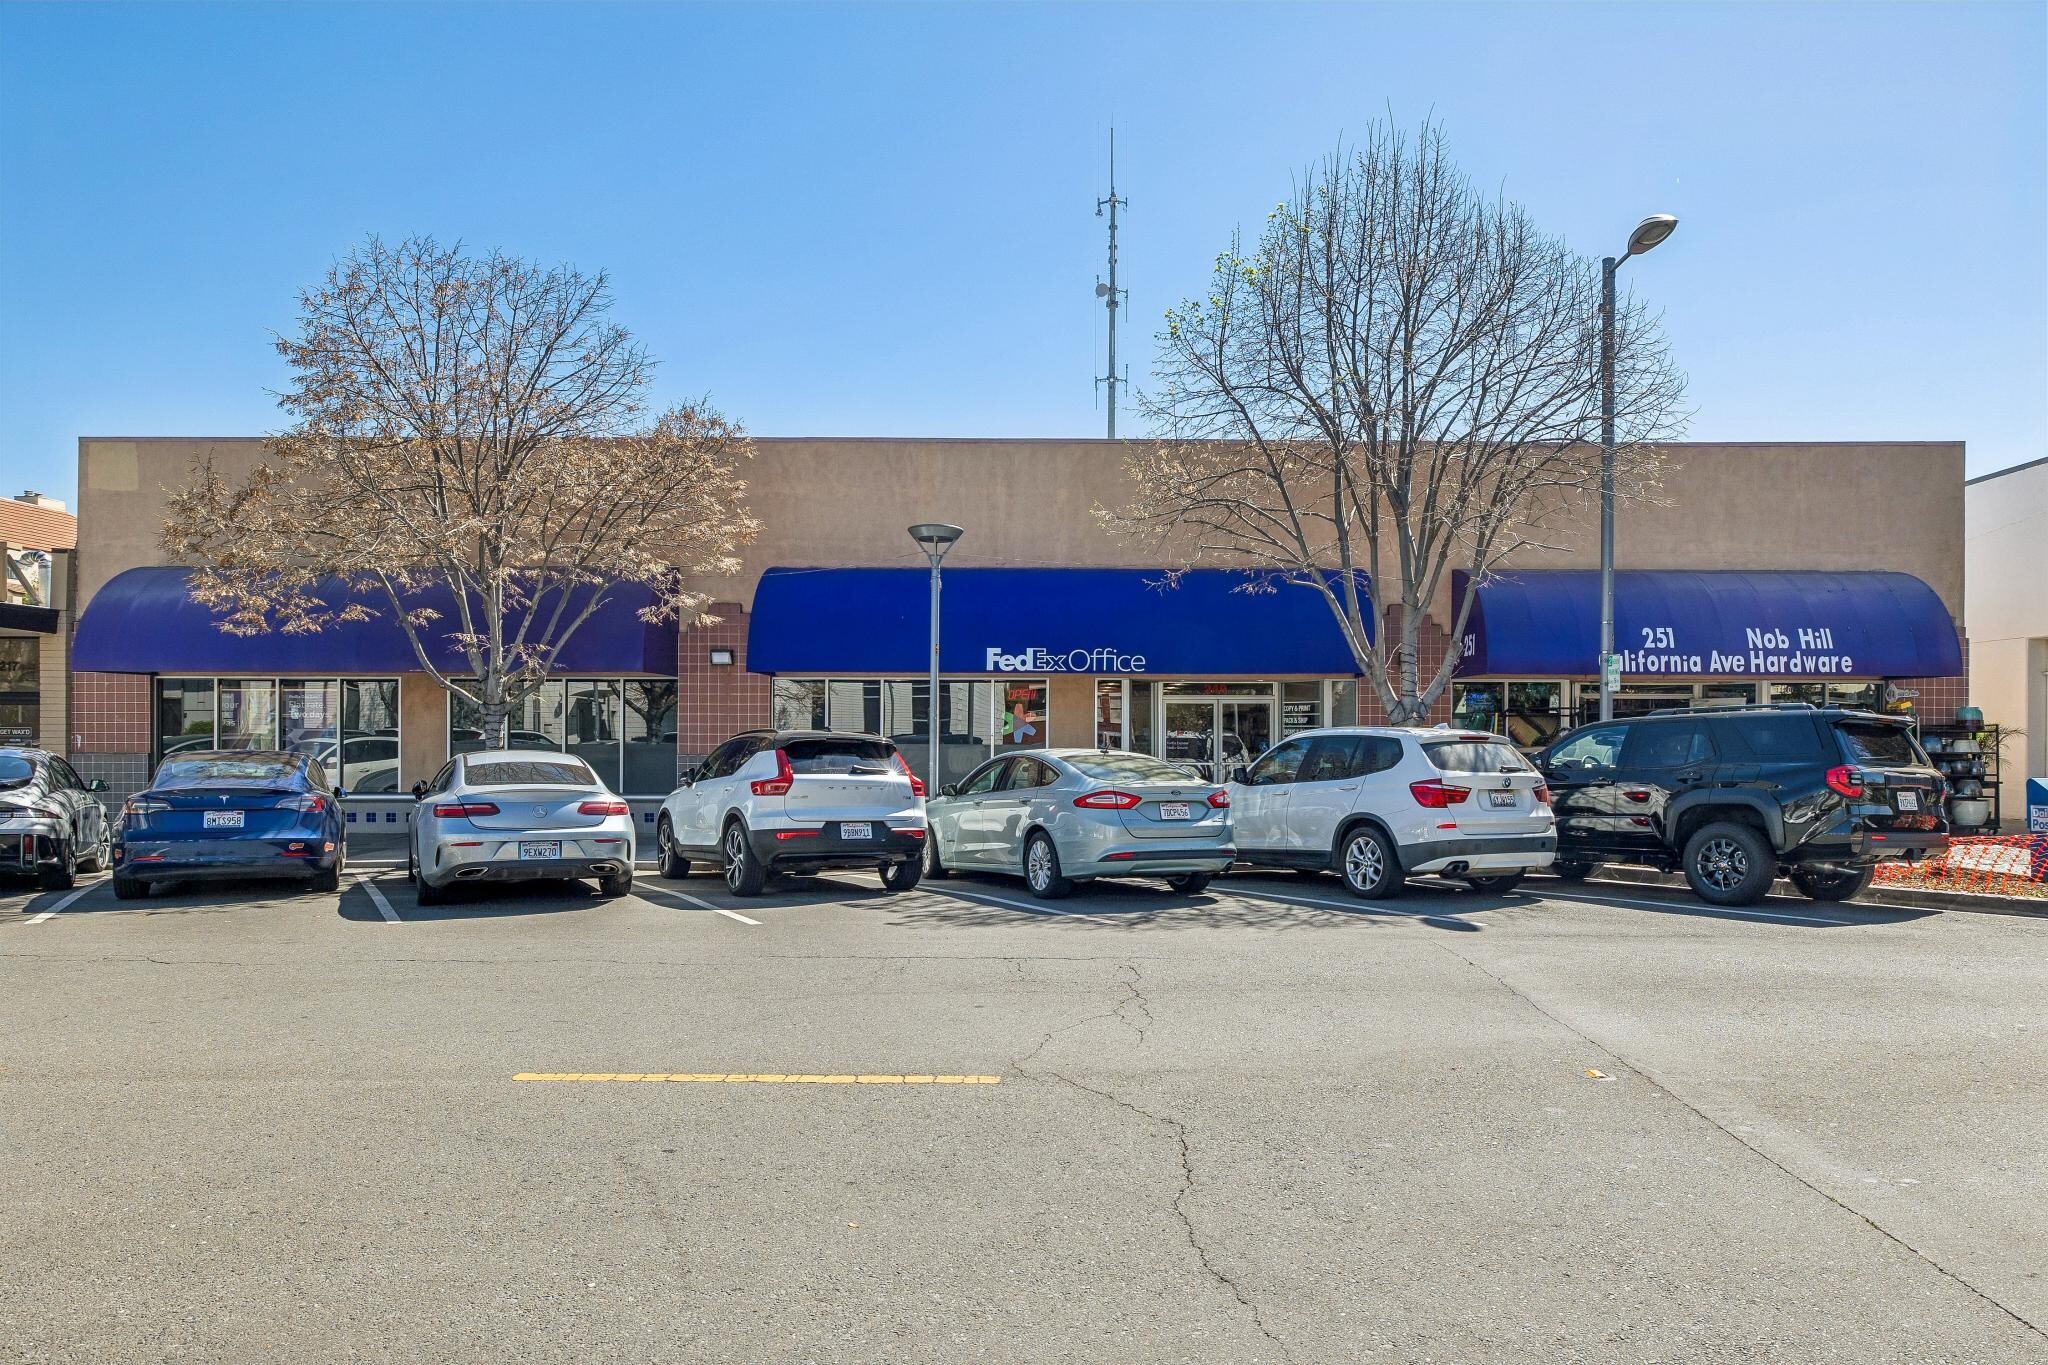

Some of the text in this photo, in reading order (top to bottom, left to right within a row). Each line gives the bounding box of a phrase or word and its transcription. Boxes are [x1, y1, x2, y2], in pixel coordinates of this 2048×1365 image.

[1464, 633, 1476, 657] 251
[1641, 628, 1675, 649] 251
[1746, 628, 1833, 649] Nob Hill
[986, 647, 1146, 672] FedEx Office
[1598, 650, 1745, 673] lifornia Ave
[1750, 651, 1853, 673] Hardware
[1007, 688, 1037, 700] OPEN
[206, 817, 242, 826] 8MIS958
[1162, 808, 1189, 817] 7DCP456
[523, 847, 557, 857] 9EXW270
